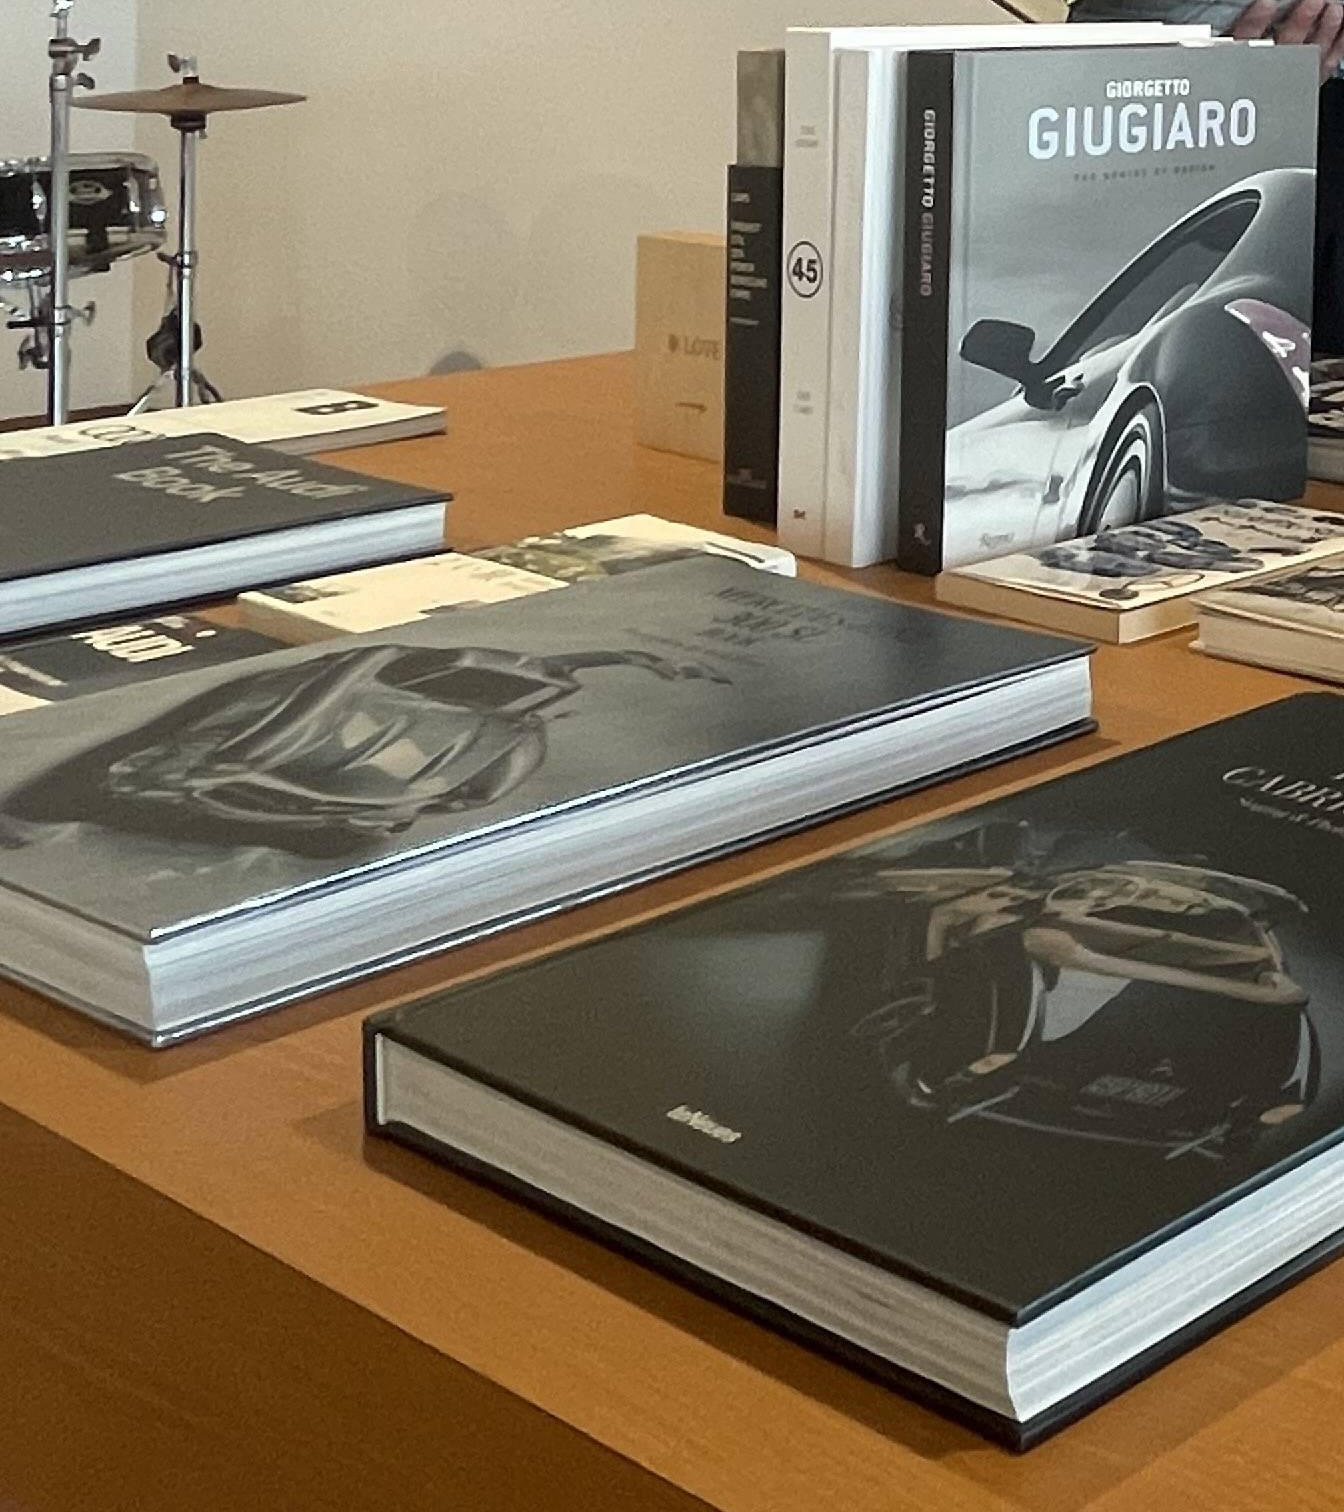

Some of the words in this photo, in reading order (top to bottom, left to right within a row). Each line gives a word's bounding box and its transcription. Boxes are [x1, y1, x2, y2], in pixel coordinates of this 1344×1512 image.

[1106, 78, 1190, 99] GIORGETTO
[1027, 99, 1257, 160] GIUGIARO
[921, 108, 936, 208] GIORGETTO
[791, 256, 818, 285] 45
[919, 212, 934, 296] GIUGIARO
[163, 445, 255, 474] The
[111, 465, 246, 504] Book
[70, 624, 196, 663] AUDI
